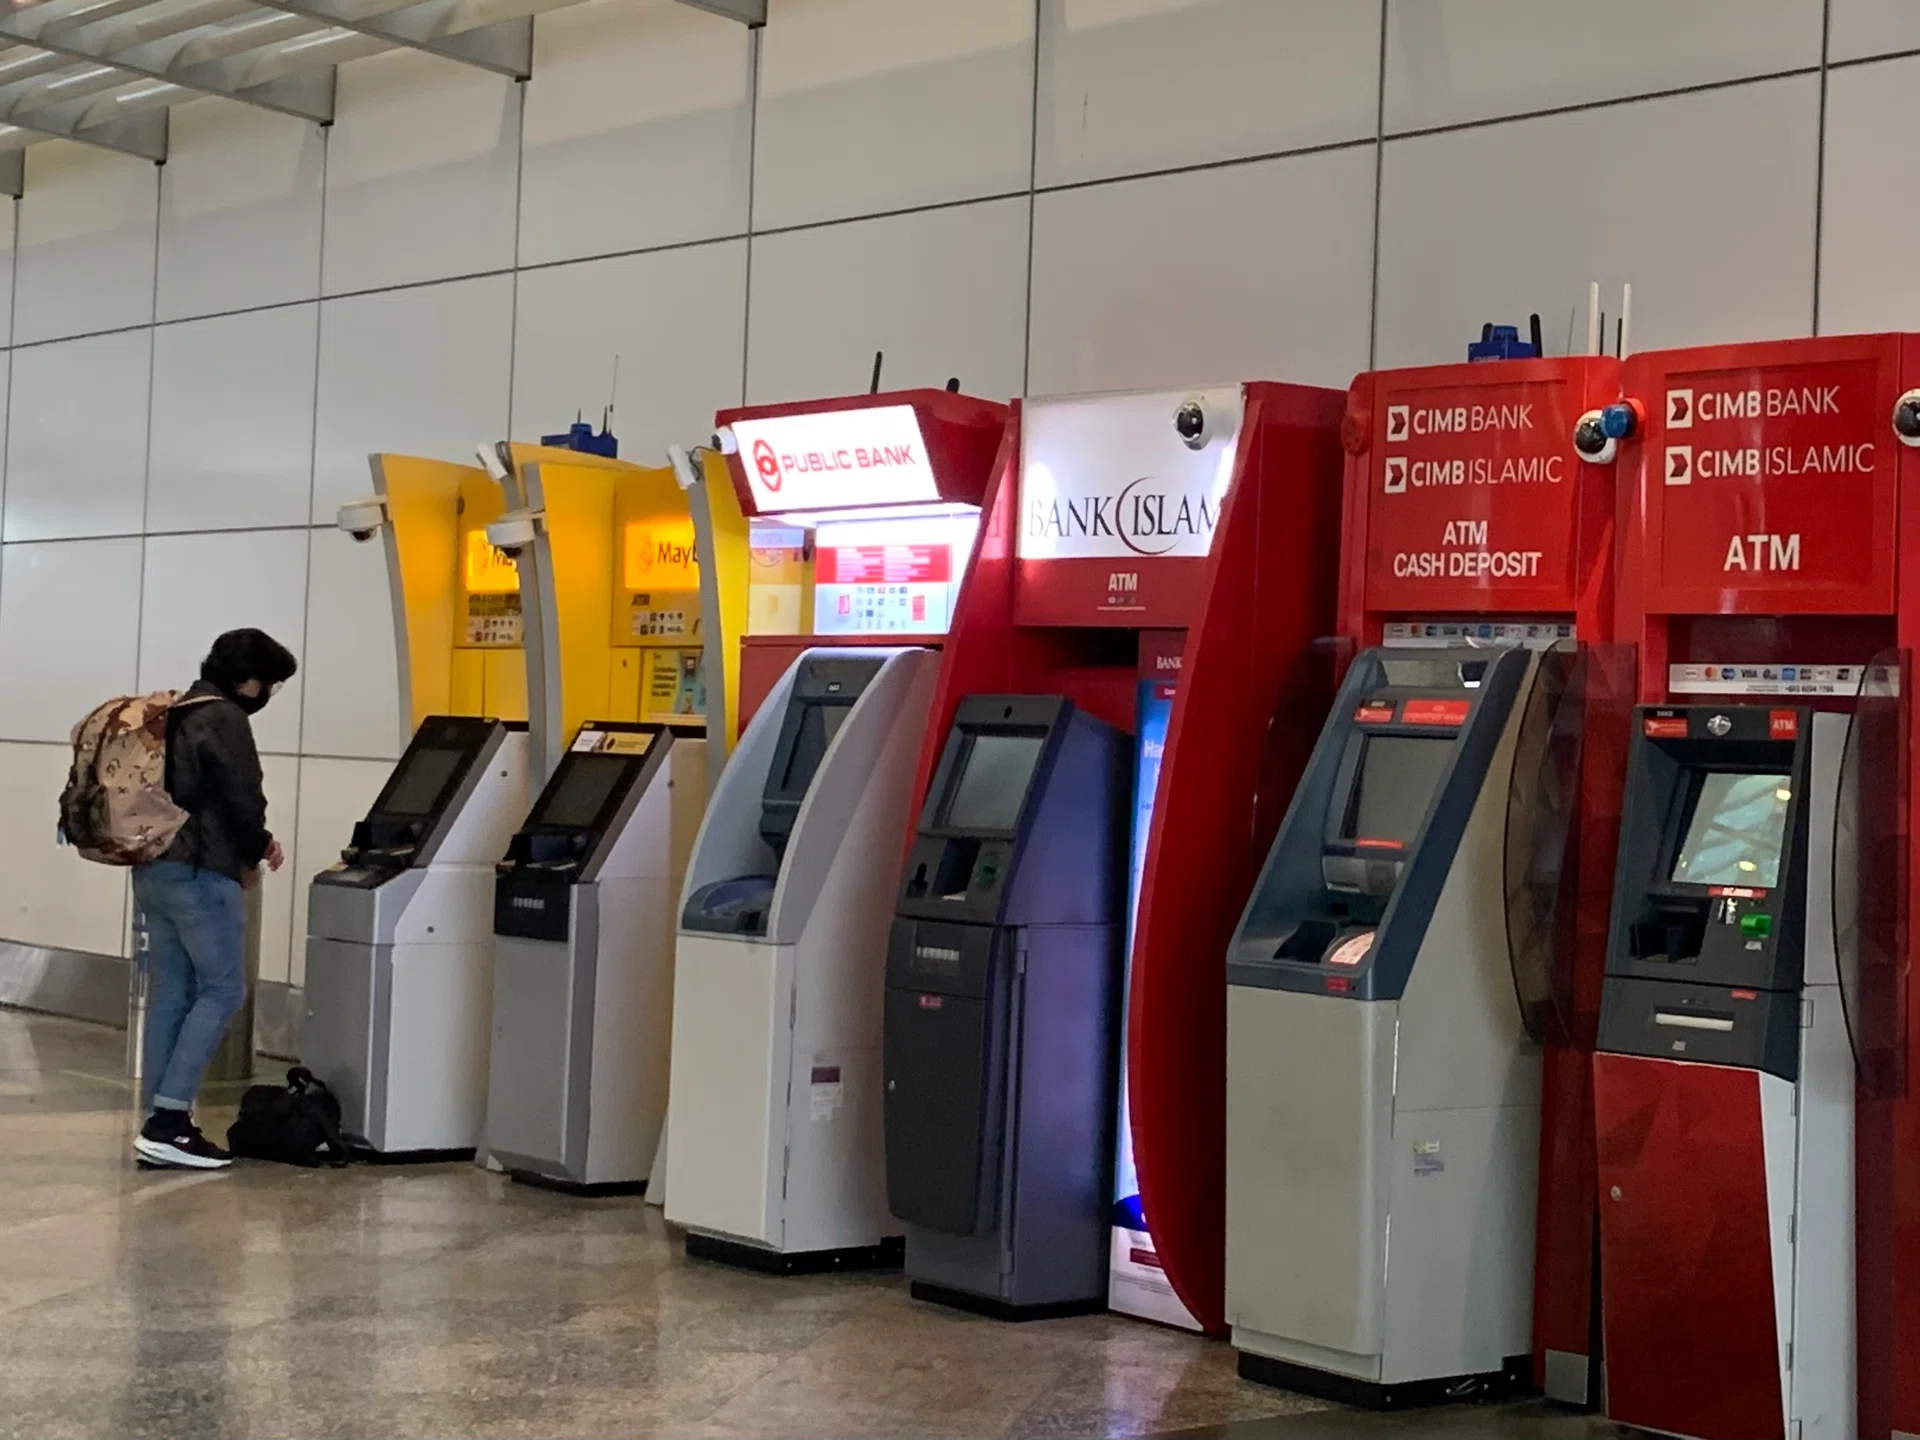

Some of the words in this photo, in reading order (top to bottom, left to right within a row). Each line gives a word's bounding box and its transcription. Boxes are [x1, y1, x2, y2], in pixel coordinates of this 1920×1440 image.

[1413, 407, 1467, 435] CIMB
[1470, 403, 1533, 432] BANK
[1697, 390, 1761, 421] CIMB
[1766, 385, 1840, 417] BANK
[782, 449, 852, 473] PUBLIC
[856, 444, 916, 468] BANK
[1411, 460, 1464, 487] CIMB
[1468, 455, 1563, 485] ISLAMIC
[1697, 448, 1760, 478] CIMB
[1765, 443, 1875, 475] ISLAMIC
[1029, 496, 1115, 537] BANK
[1442, 520, 1488, 546] ATM
[1393, 553, 1445, 577] CASH
[1449, 551, 1542, 577] DEPOSIT
[1723, 534, 1800, 571] ATM
[1108, 573, 1138, 591] ATM
[1772, 719, 1795, 731] ATM
